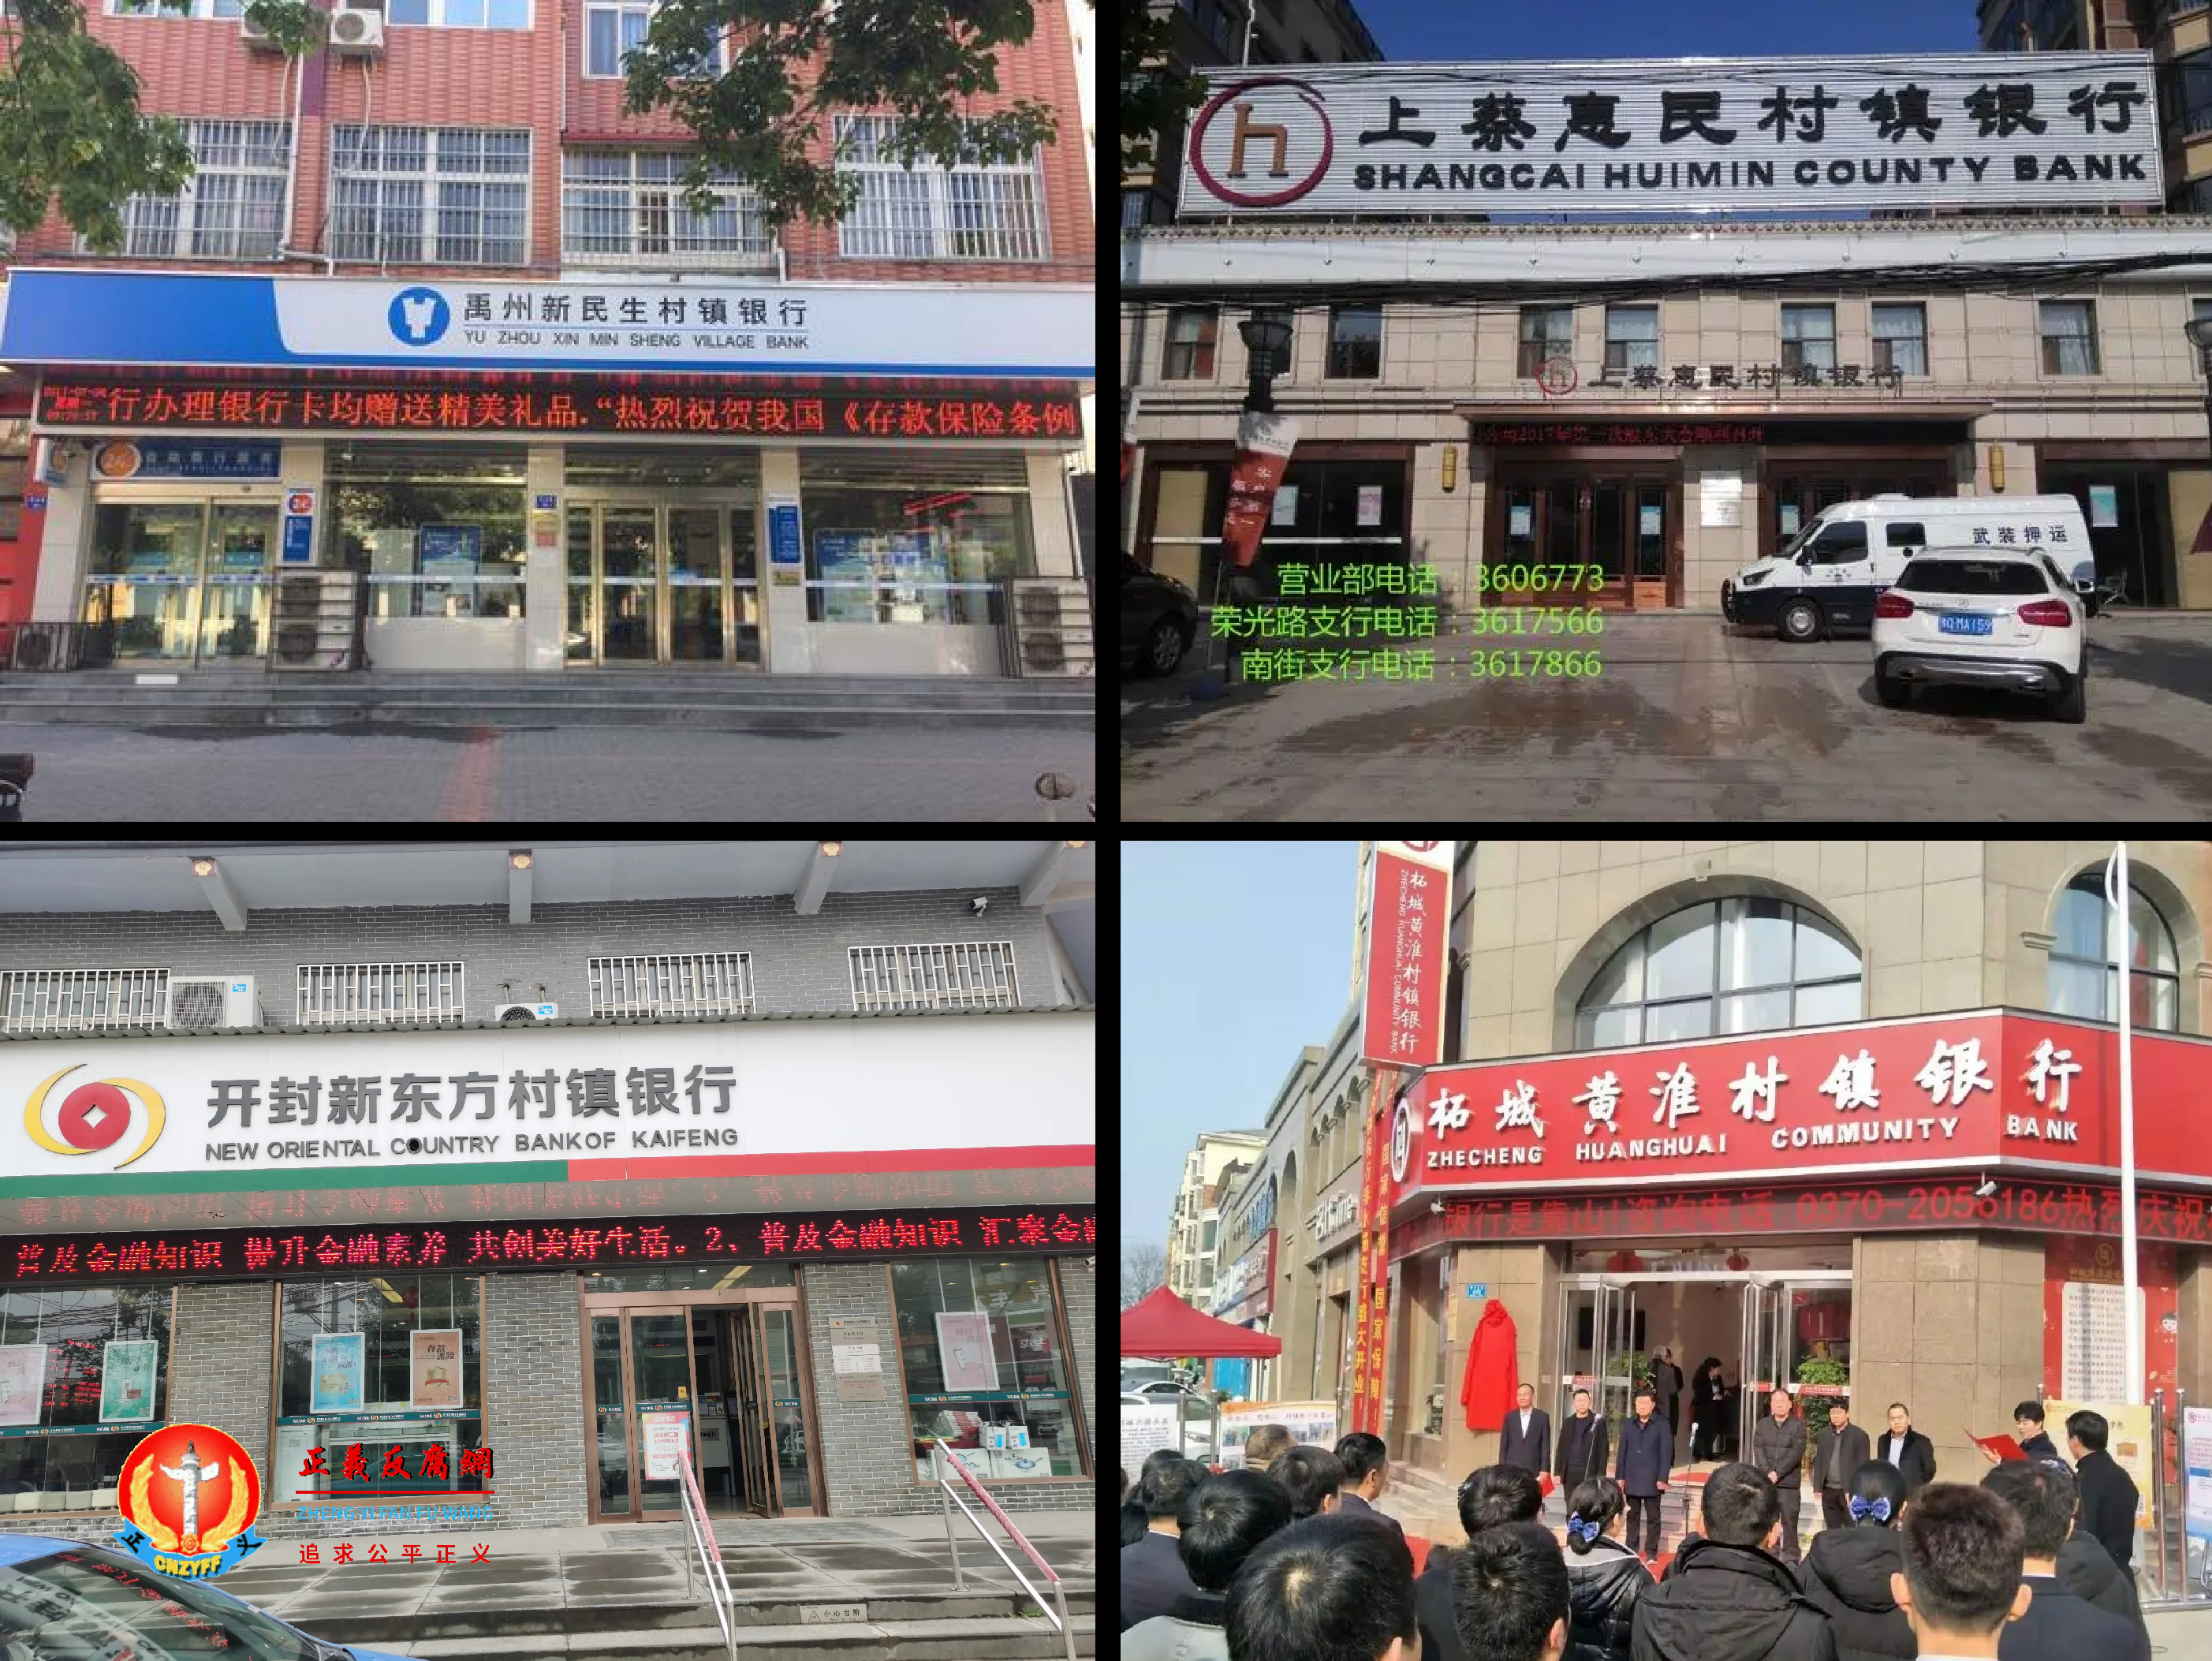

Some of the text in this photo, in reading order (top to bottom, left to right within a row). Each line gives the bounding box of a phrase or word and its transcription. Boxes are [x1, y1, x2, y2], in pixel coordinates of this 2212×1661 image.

[1359, 81, 2146, 152] 上蔡惠民村镇银行
[1353, 154, 2146, 190] SHANGCAI HUIMIN COUNTY BANK
[464, 292, 807, 327] 禹州新民生村镇银行
[465, 330, 808, 349] YU ZHOU XIN MIN SHENG VILLAGE BANK
[1972, 524, 2068, 546] 武装押运
[1399, 869, 1428, 1054] 柘城黄淮村镇银行
[207, 1064, 737, 1128] 开封新东方村镇银行
[1427, 1037, 2082, 1140] 柘城黄淮村镇银行
[205, 1143, 259, 1161] NEW
[267, 1139, 380, 1159] ORIENTAL
[390, 1135, 500, 1155] COUNTRY
[632, 1128, 739, 1148] KAIFENG
[1427, 1114, 2078, 1168] ZHECHENG HUANGHUAI COMMUNITY BANK
[823, 1608, 860, 1617] 小心台阶
